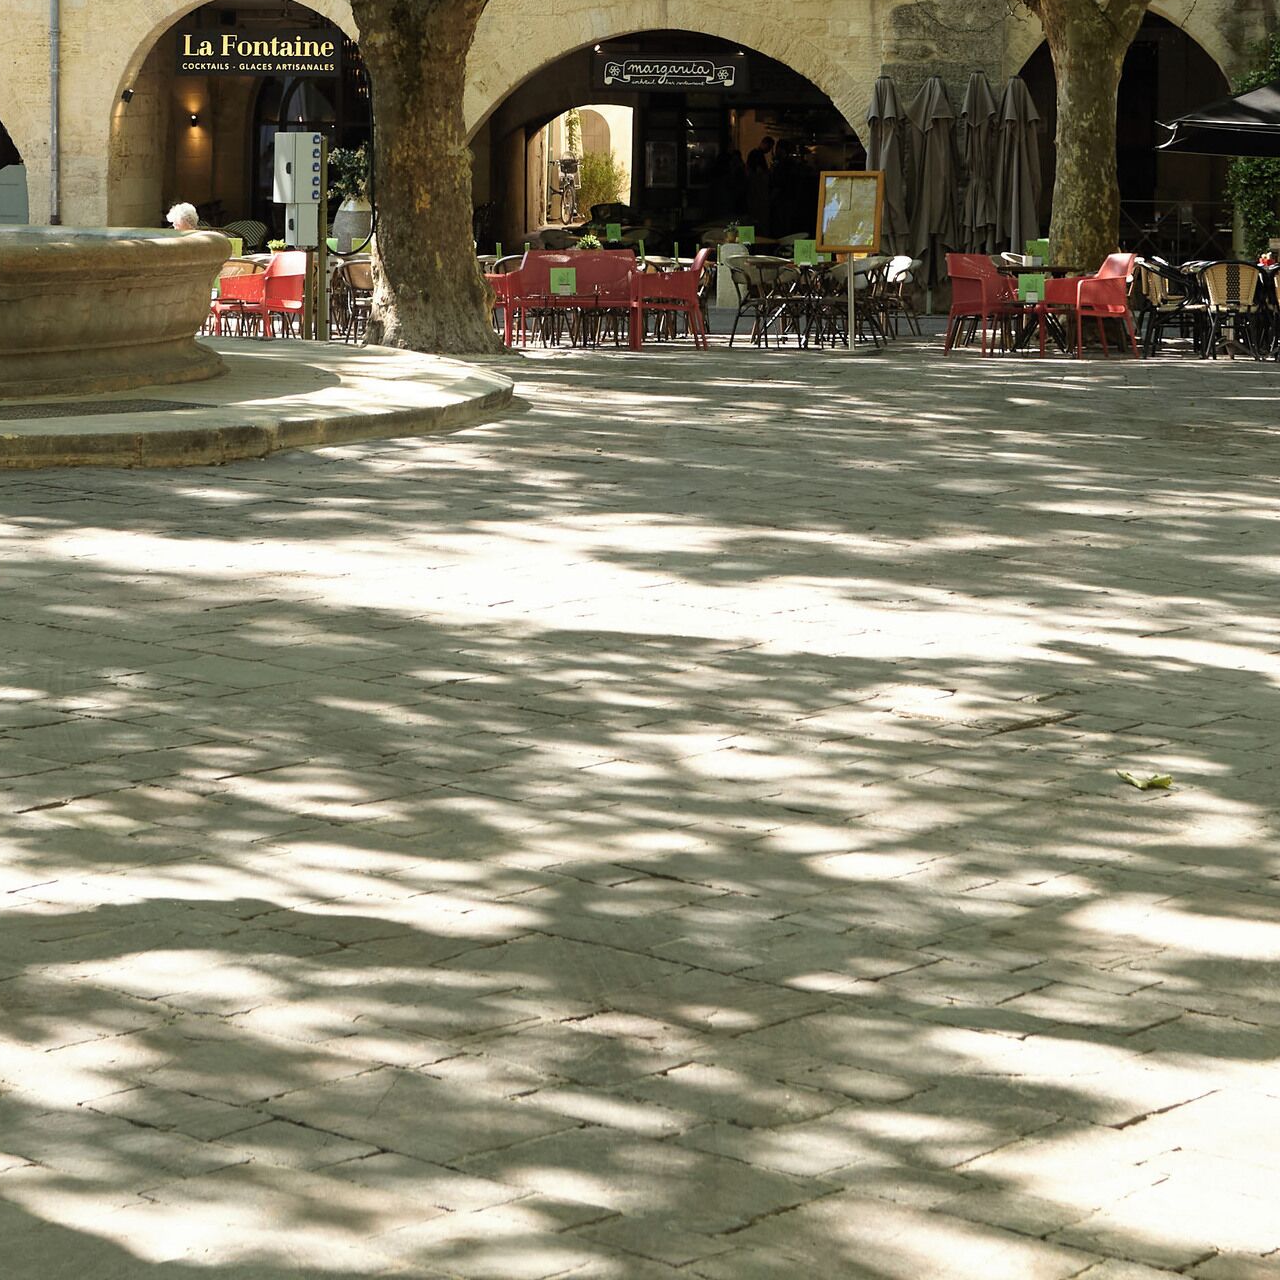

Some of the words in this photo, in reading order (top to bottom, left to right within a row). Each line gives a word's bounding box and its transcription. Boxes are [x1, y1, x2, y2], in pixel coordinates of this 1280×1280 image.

[183, 34, 214, 56] La
[221, 34, 334, 57] Fontaine
[182, 62, 230, 70] COCKTAILS
[239, 62, 272, 70] GLACES
[627, 63, 710, 84] margarita
